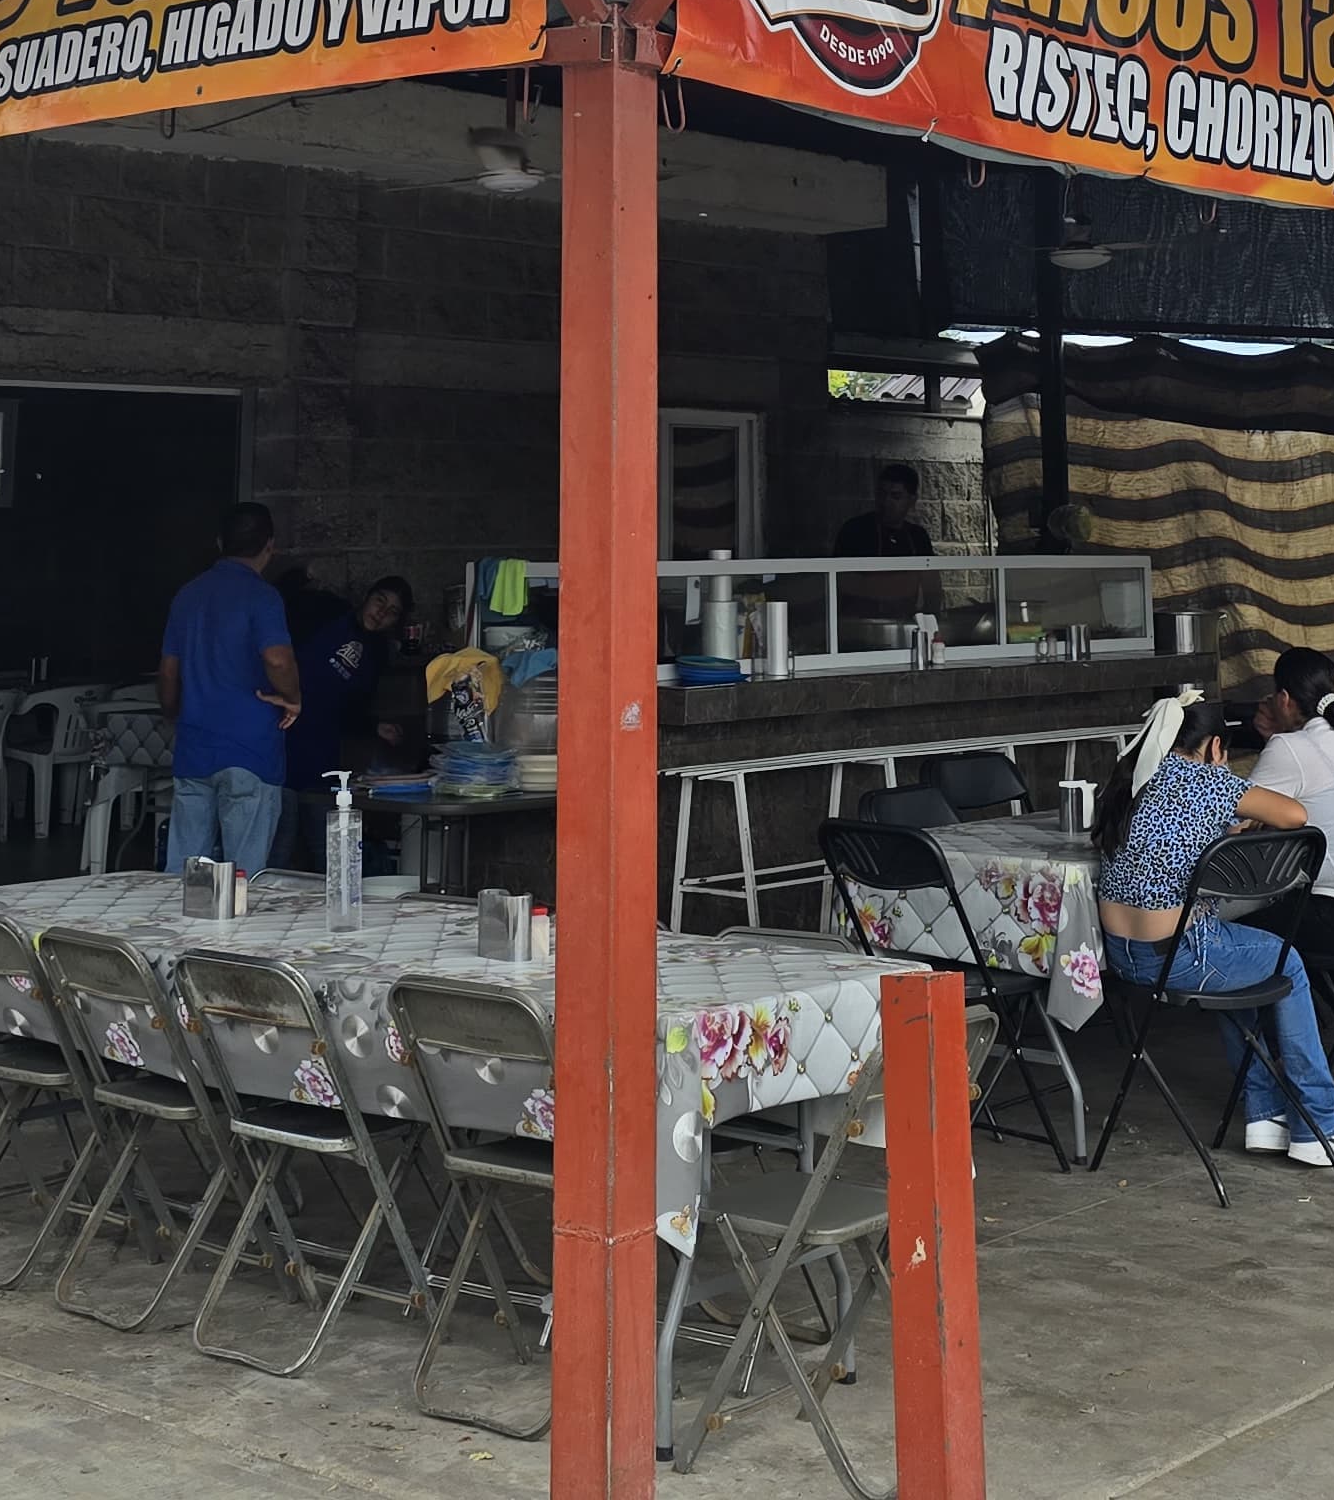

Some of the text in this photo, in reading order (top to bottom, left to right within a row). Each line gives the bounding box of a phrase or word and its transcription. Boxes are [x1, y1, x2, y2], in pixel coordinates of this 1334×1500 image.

[819, 24, 896, 67] DESDE 1990
[989, 25, 1156, 157] BISTEC,
